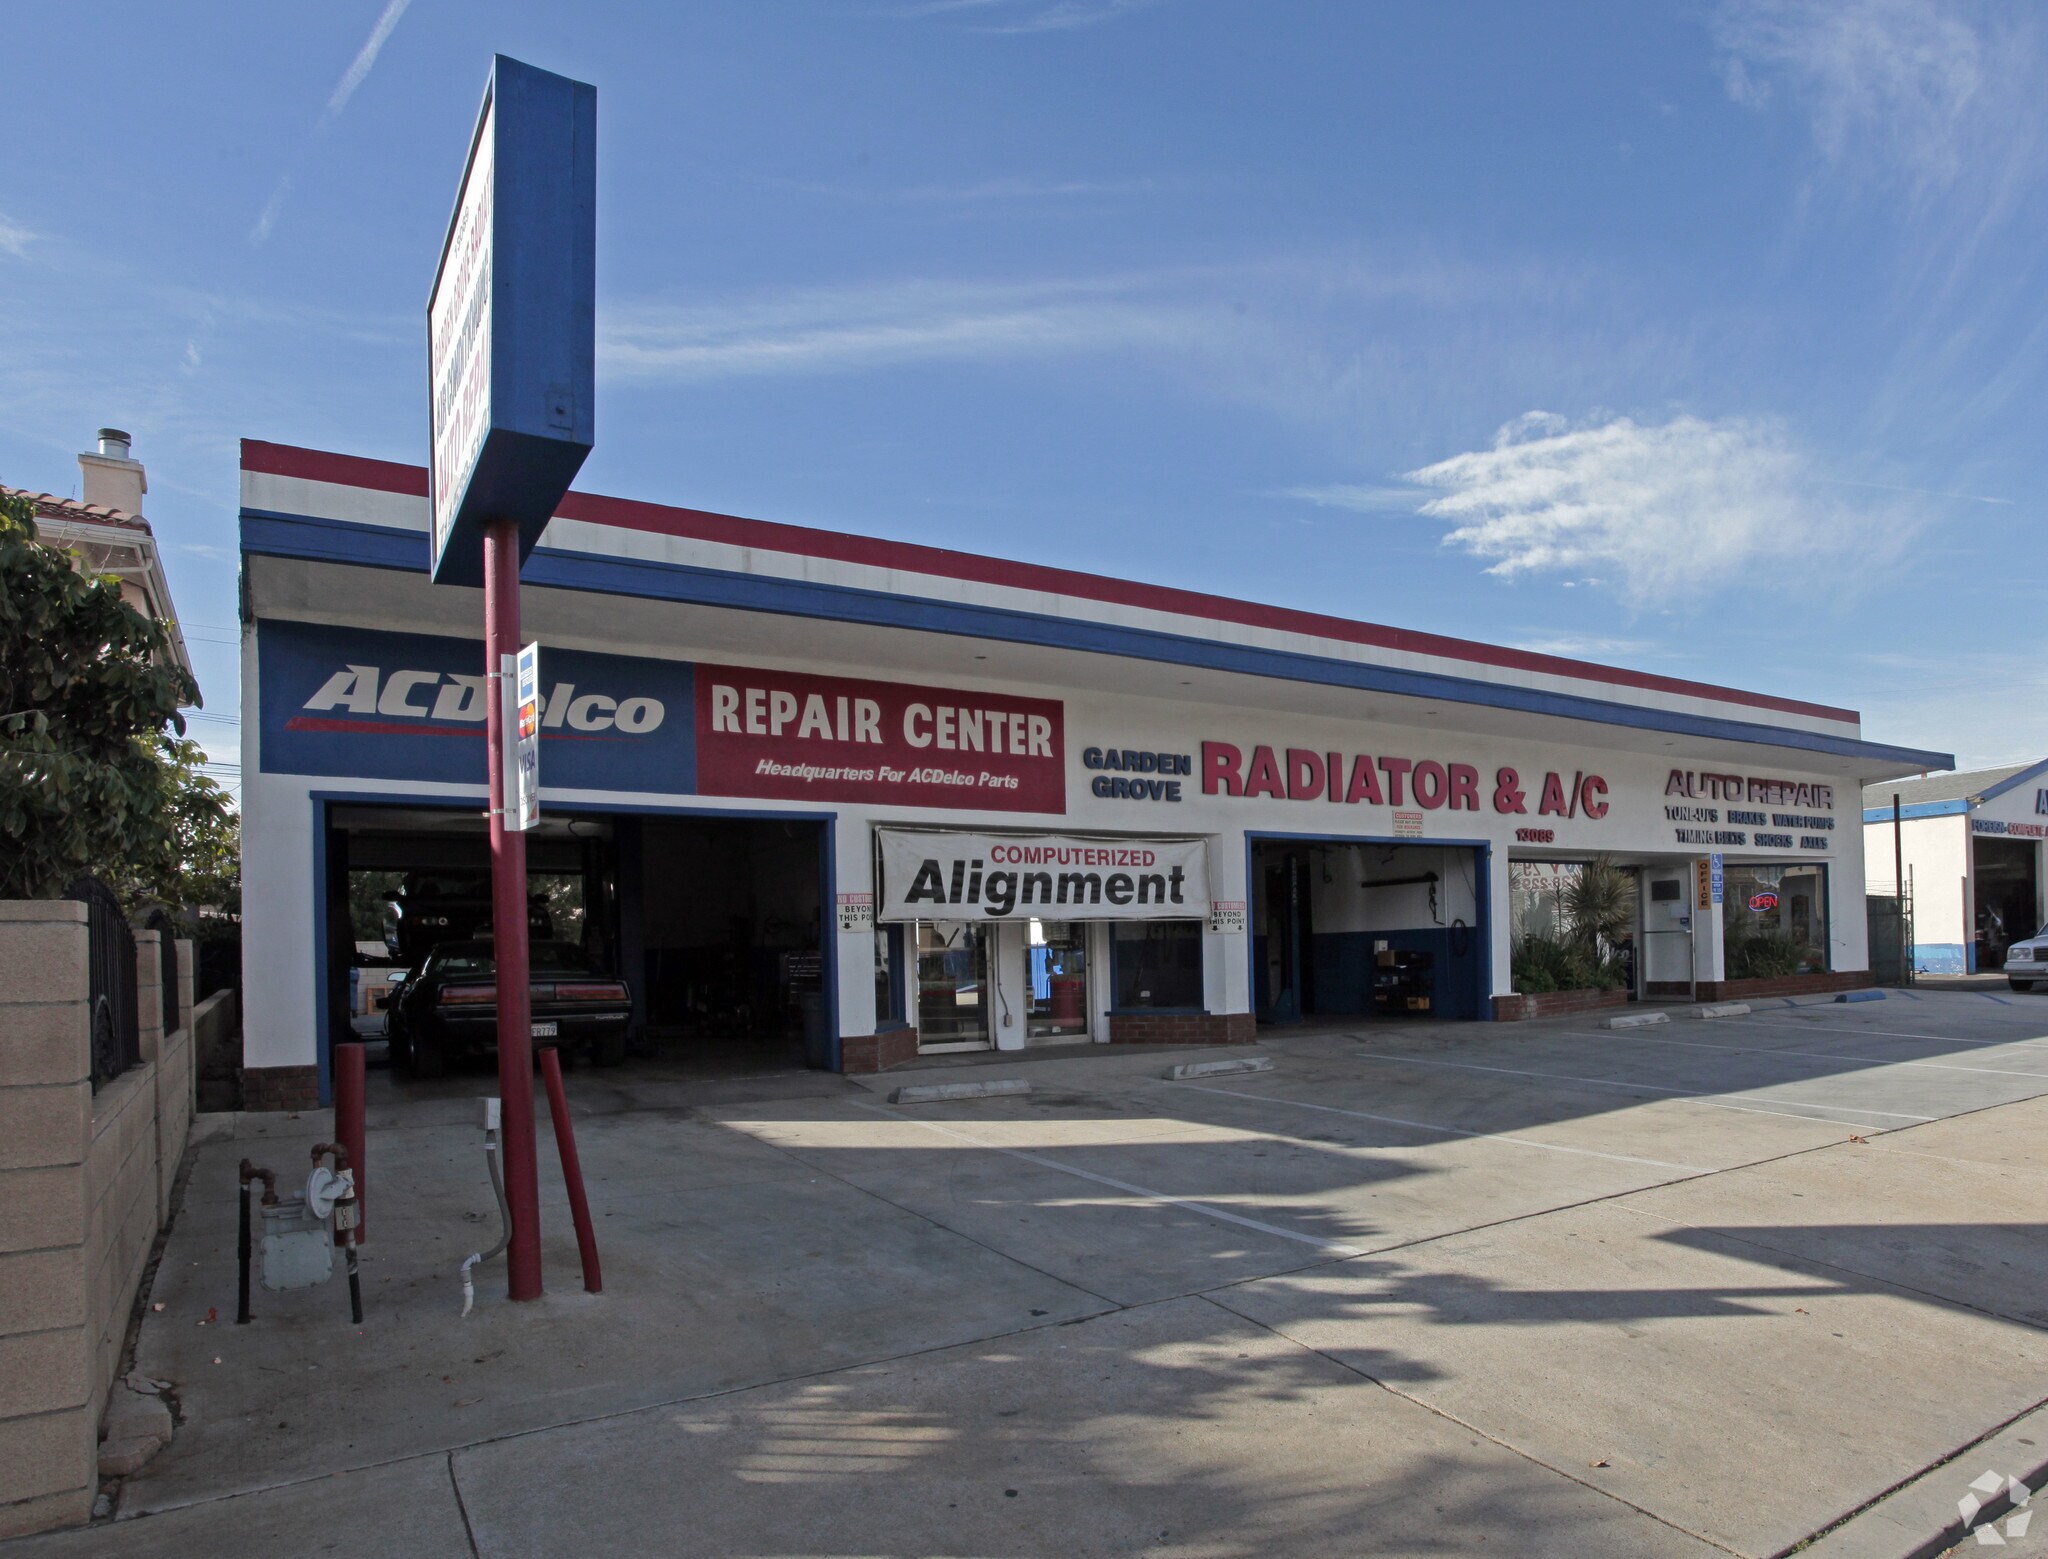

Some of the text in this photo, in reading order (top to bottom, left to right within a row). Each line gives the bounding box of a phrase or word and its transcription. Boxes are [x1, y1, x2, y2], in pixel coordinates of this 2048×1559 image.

[435, 297, 453, 379] GARDEN
[453, 240, 470, 324] GROVE
[437, 382, 447, 445] AIR
[439, 408, 460, 514] AUTO
[303, 664, 666, 734] ACDlco
[712, 684, 1054, 758] REPAIR CENTER
[519, 749, 536, 775] VISA
[755, 758, 1019, 789] Headquarters For ACDelco Parts
[1083, 746, 1192, 776] GARDEN
[1092, 775, 1182, 802] GROVE
[1201, 740, 1610, 820] RADIATOR & A/C
[1665, 769, 1834, 809] AUTO REPAIR
[1515, 828, 1555, 844] 13089
[1728, 810, 1768, 827] BRAKES
[1772, 813, 1804, 829] WATER
[1804, 815, 1836, 831] PUMPS
[991, 845, 1155, 868] COMPUTERIZED
[1676, 829, 1829, 853] TIMING BELTS SHOCKS AXLES
[838, 895, 847, 904] NO
[904, 858, 1186, 917] Alignment
[1700, 862, 1708, 906] OFFICE
[1749, 896, 1779, 909] OPEN
